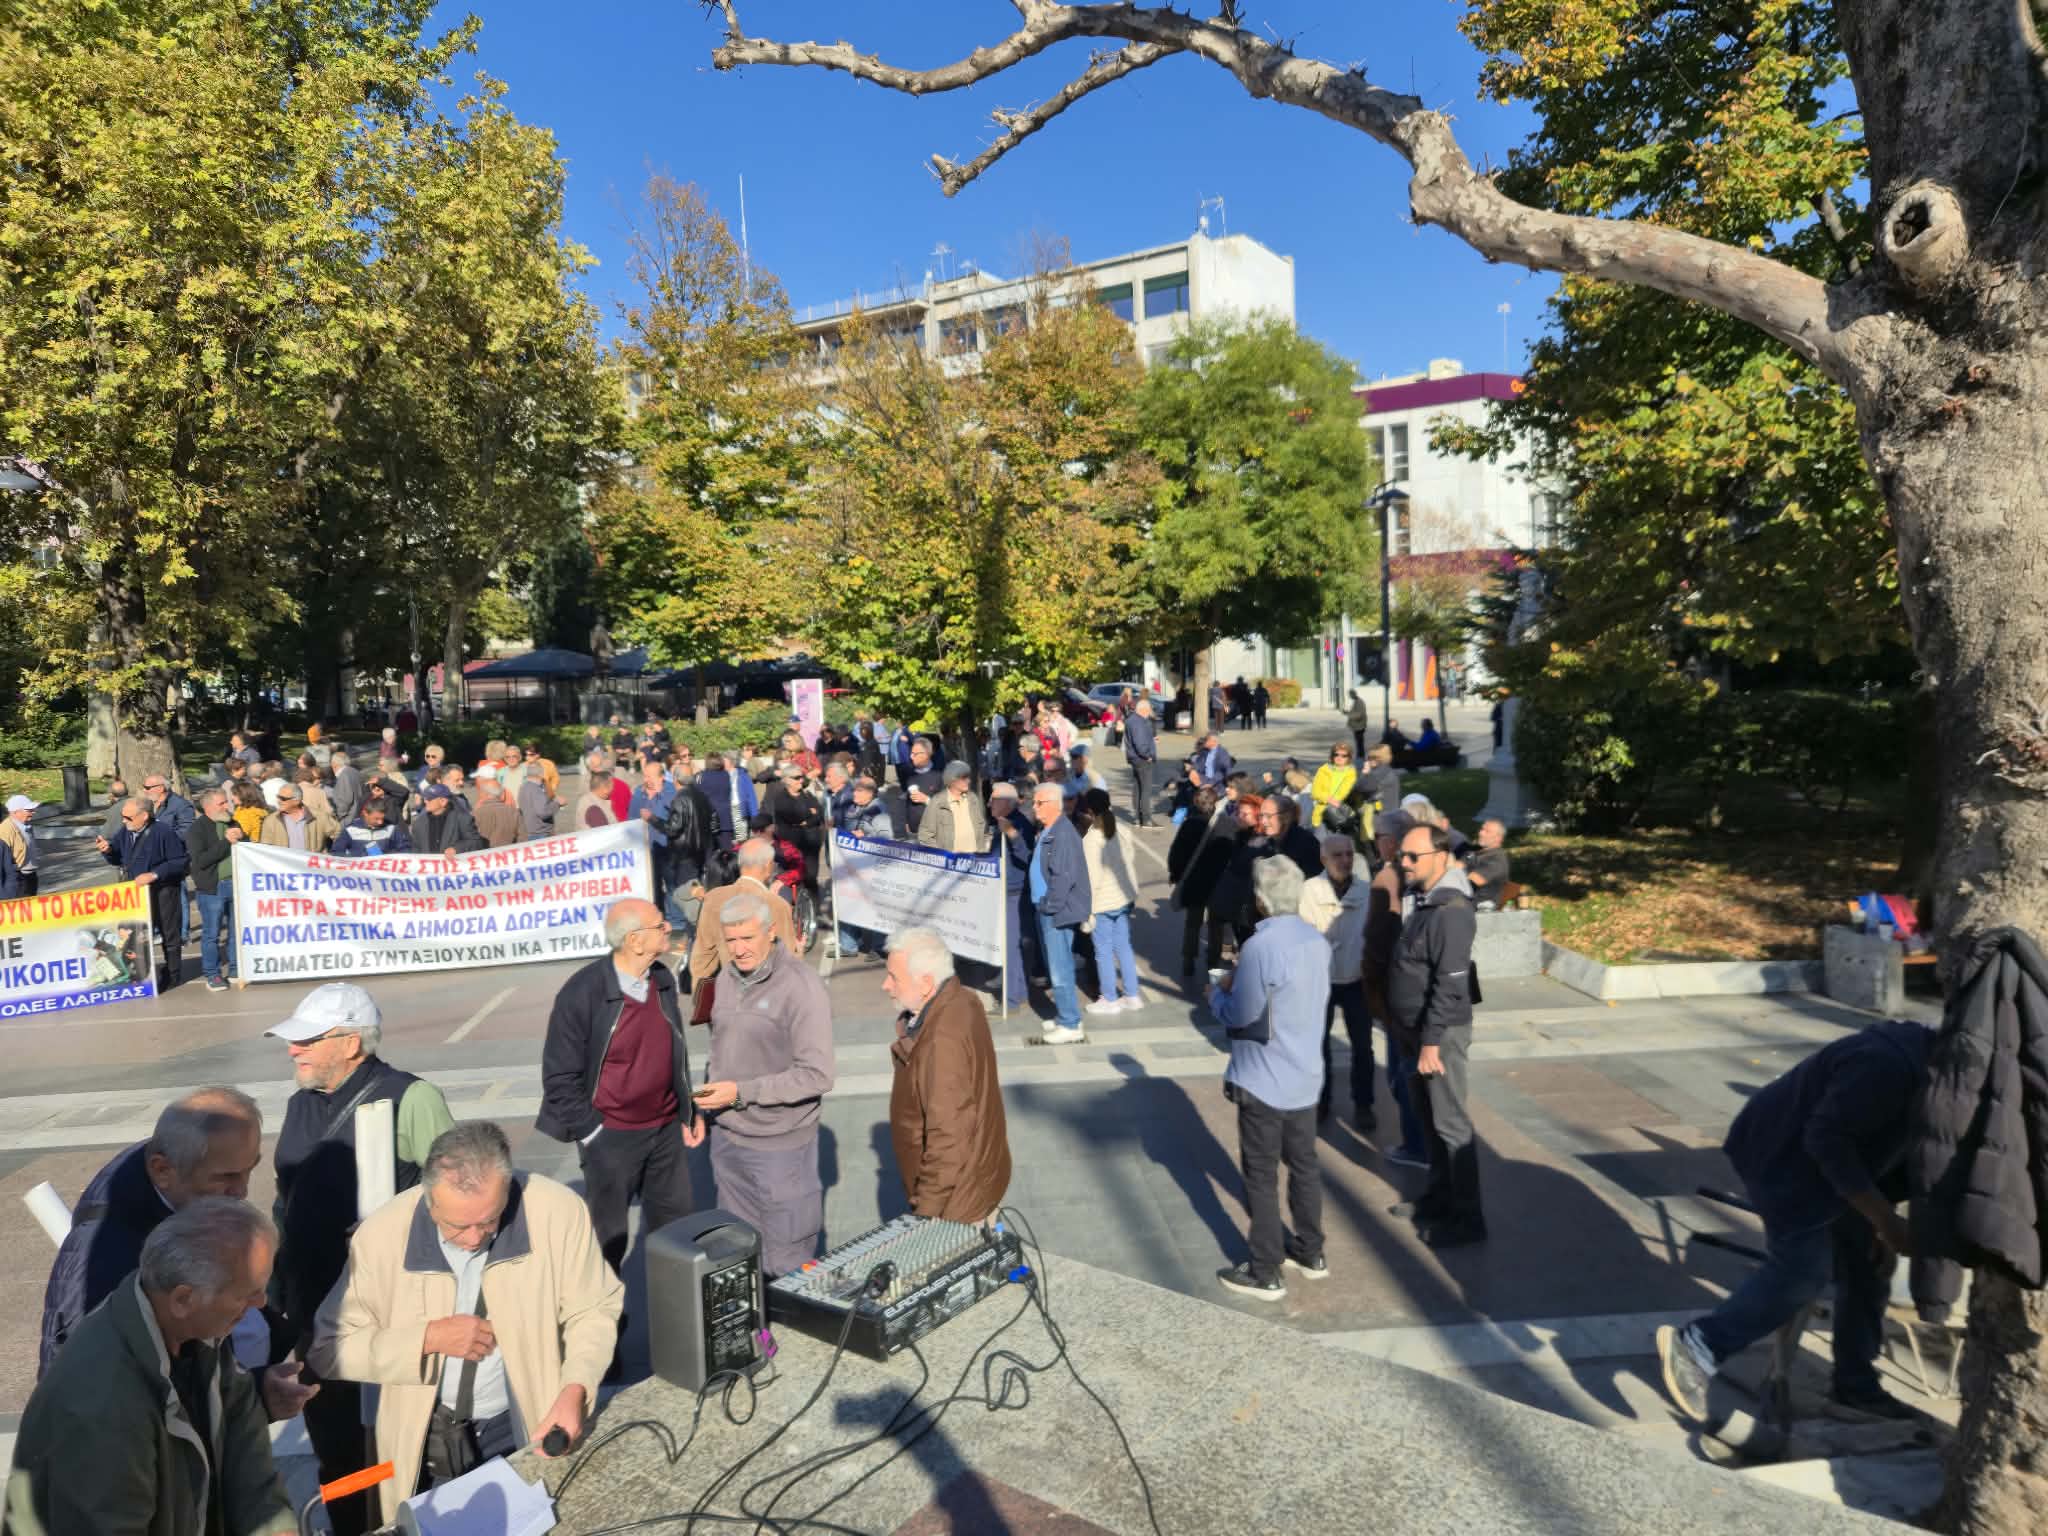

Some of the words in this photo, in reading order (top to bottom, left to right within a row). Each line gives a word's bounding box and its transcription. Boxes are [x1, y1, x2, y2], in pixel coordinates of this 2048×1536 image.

[251, 873, 372, 891] ΕΠΙΣΤΡΟΦΗ
[376, 877, 421, 892] ΤΩΝ
[427, 850, 635, 891] ΠΑΡΑΚΡΑΤΗΘΕΝΤΩΝ
[417, 858, 463, 874] ΣΤΙΣ
[467, 837, 579, 871] ΣΥΝΤΑΞΕΙΣ
[39, 895, 64, 920] ΤΟ
[71, 885, 141, 917] ΚΕΦΑΛΙ
[257, 897, 329, 918] ΜΕΤΡΑ
[335, 897, 438, 916] ΣΤΗΡΙΞΗΣ
[445, 894, 487, 911] ΑΠΟ
[494, 888, 534, 907] ΤΗΝ
[542, 876, 632, 902] ΑΚΡΙΒΕΙΑ
[242, 922, 396, 945] ΑΠΟΚΛΕΙΣΤΙΚΑ
[403, 915, 497, 939] ΔΗΜΟΣΙΑ
[505, 906, 587, 931] ΔΩΡΕΑΝ
[253, 953, 354, 974] ΣΩΜΑΤΕΙΟ
[360, 944, 506, 968] ΣΥΝΤΑΞΙΟΥΧΩΝ
[512, 940, 544, 957] ΙΚΑ
[1, 998, 57, 1016] ΟΑΕΕ
[62, 986, 145, 1007] ΛΑΡΙΣΑΣ
[884, 1274, 950, 1318] EUROPOWER
